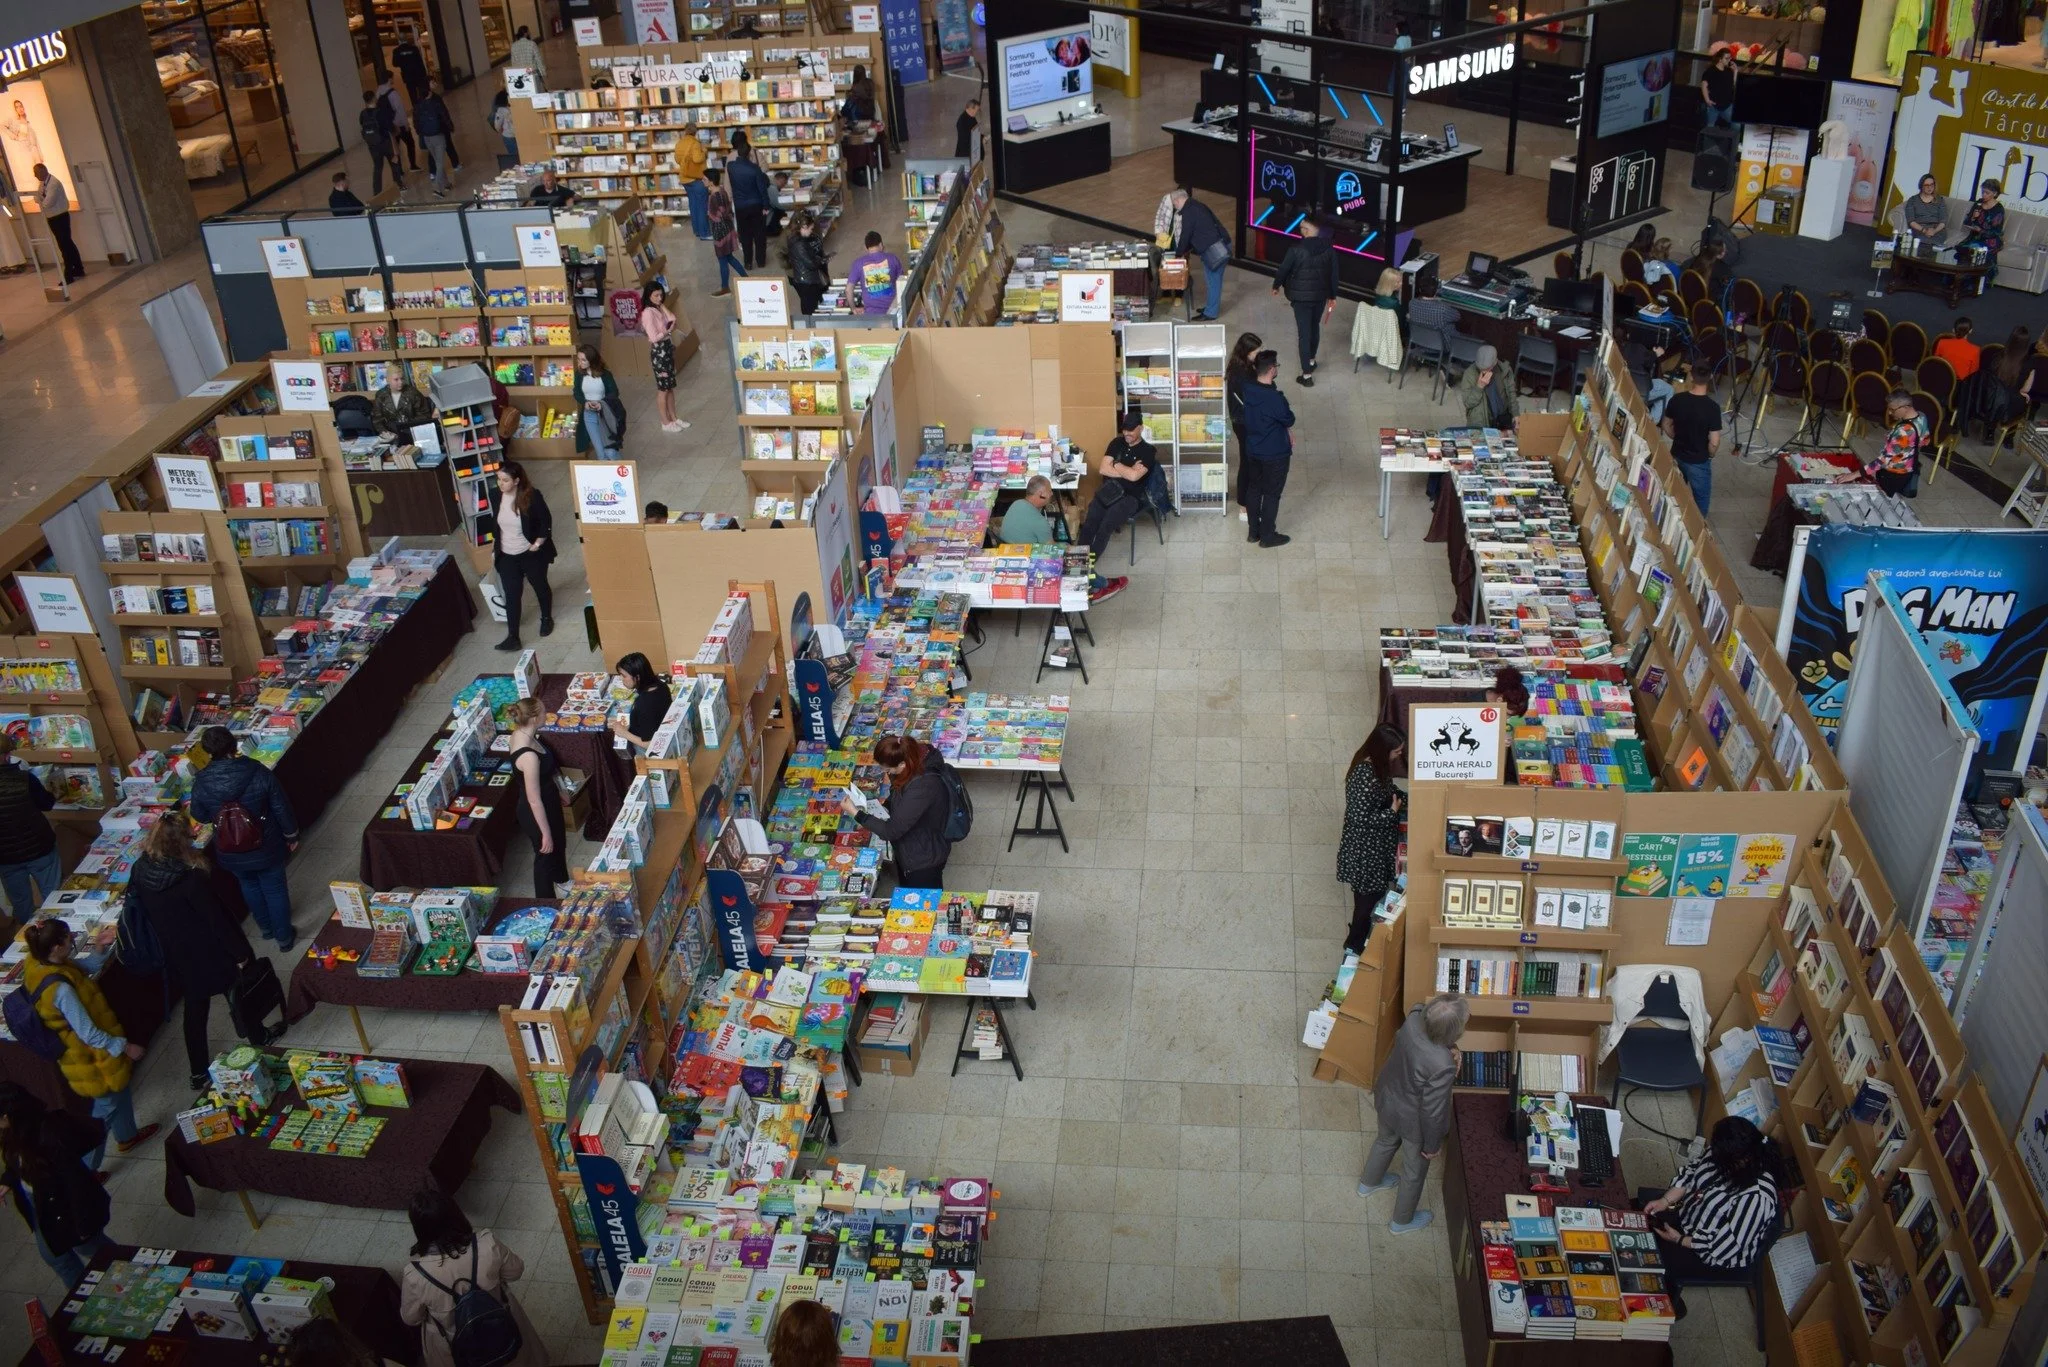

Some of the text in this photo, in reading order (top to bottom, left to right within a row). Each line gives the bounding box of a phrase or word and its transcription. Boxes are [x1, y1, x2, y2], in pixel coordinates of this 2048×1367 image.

[0, 30, 67, 78] arius
[1009, 51, 1035, 62] Samsung
[1009, 57, 1048, 70] Entertainment
[1009, 69, 1031, 78] Festival
[1408, 43, 1515, 95] SAMSUNG
[1343, 196, 1366, 212] PUBG
[167, 468, 197, 478] METEOR
[618, 466, 629, 476] 15
[170, 477, 199, 485] PRESS
[1895, 568, 1926, 578] adoră
[1929, 568, 1985, 578] aventurile
[1844, 587, 2016, 633] DG MAN
[1481, 710, 1496, 720] 10
[1456, 760, 1493, 768] HERALD
[1434, 771, 1474, 779] București
[1638, 842, 1663, 852] CĂRȚI
[1687, 850, 1724, 865] 15%
[716, 1024, 736, 1051] PLUME
[627, 1266, 652, 1275] CODUL
[836, 1268, 864, 1277] KEPLER
[656, 1276, 684, 1284] CODUL
[879, 1294, 908, 1308] NOI
